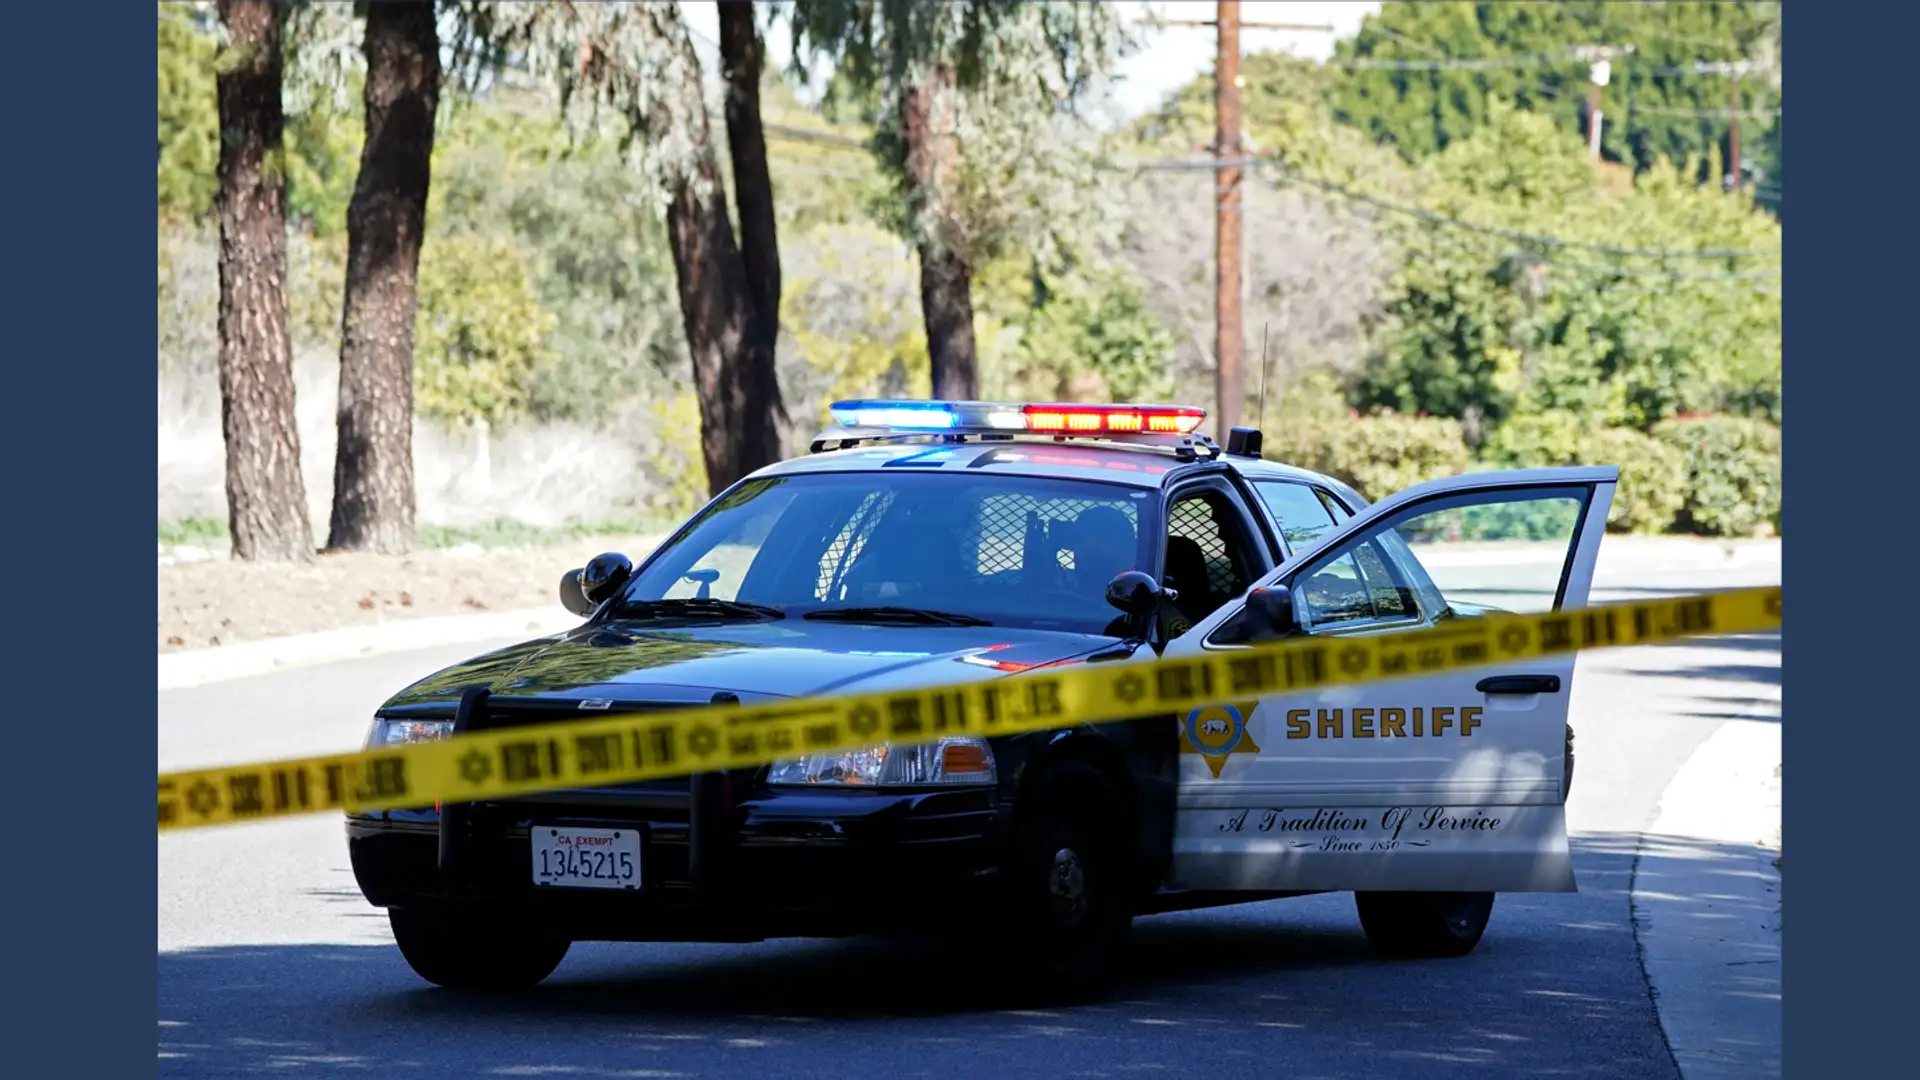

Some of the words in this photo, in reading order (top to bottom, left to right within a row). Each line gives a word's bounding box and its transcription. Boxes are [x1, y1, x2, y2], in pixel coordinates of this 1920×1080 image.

[1286, 706, 1483, 739] SHERIFF
[1219, 809, 1249, 832] A
[1258, 807, 1368, 832] Tradition
[1381, 806, 1413, 840] Of
[1418, 806, 1501, 831] Service
[558, 836, 571, 844] CA
[576, 837, 613, 845] EXEMPT
[1319, 835, 1363, 851] Since
[1369, 840, 1400, 851] 1850
[540, 848, 634, 880] 1345215
